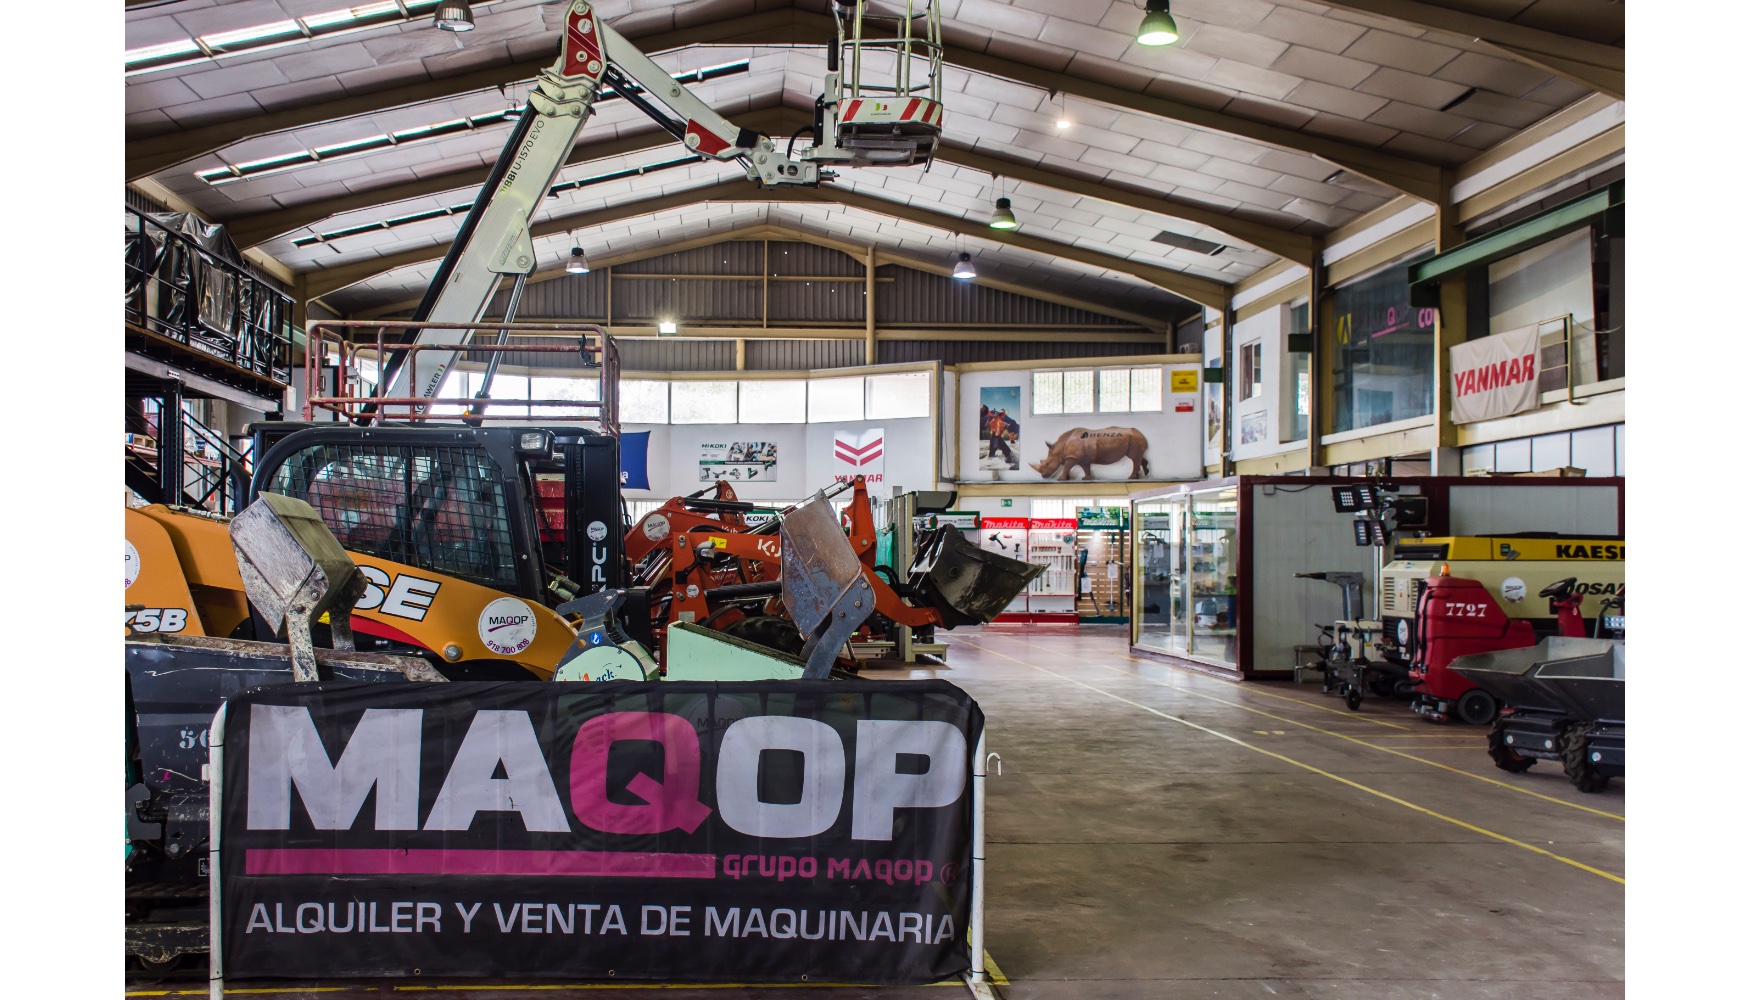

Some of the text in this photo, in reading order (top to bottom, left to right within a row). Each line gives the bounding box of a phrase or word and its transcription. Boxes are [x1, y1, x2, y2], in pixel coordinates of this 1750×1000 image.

[530, 120, 545, 141] EVO
[1454, 353, 1535, 398] YANMAR
[489, 615, 529, 625] MAQOP
[1445, 602, 1488, 617] 7727
[486, 638, 530, 654] 918 700 808
[246, 703, 967, 841] MAQOP
[827, 857, 934, 887] MAQOP
[245, 901, 955, 945] ALQUILER Y VENTA DE MAQUINARIA
